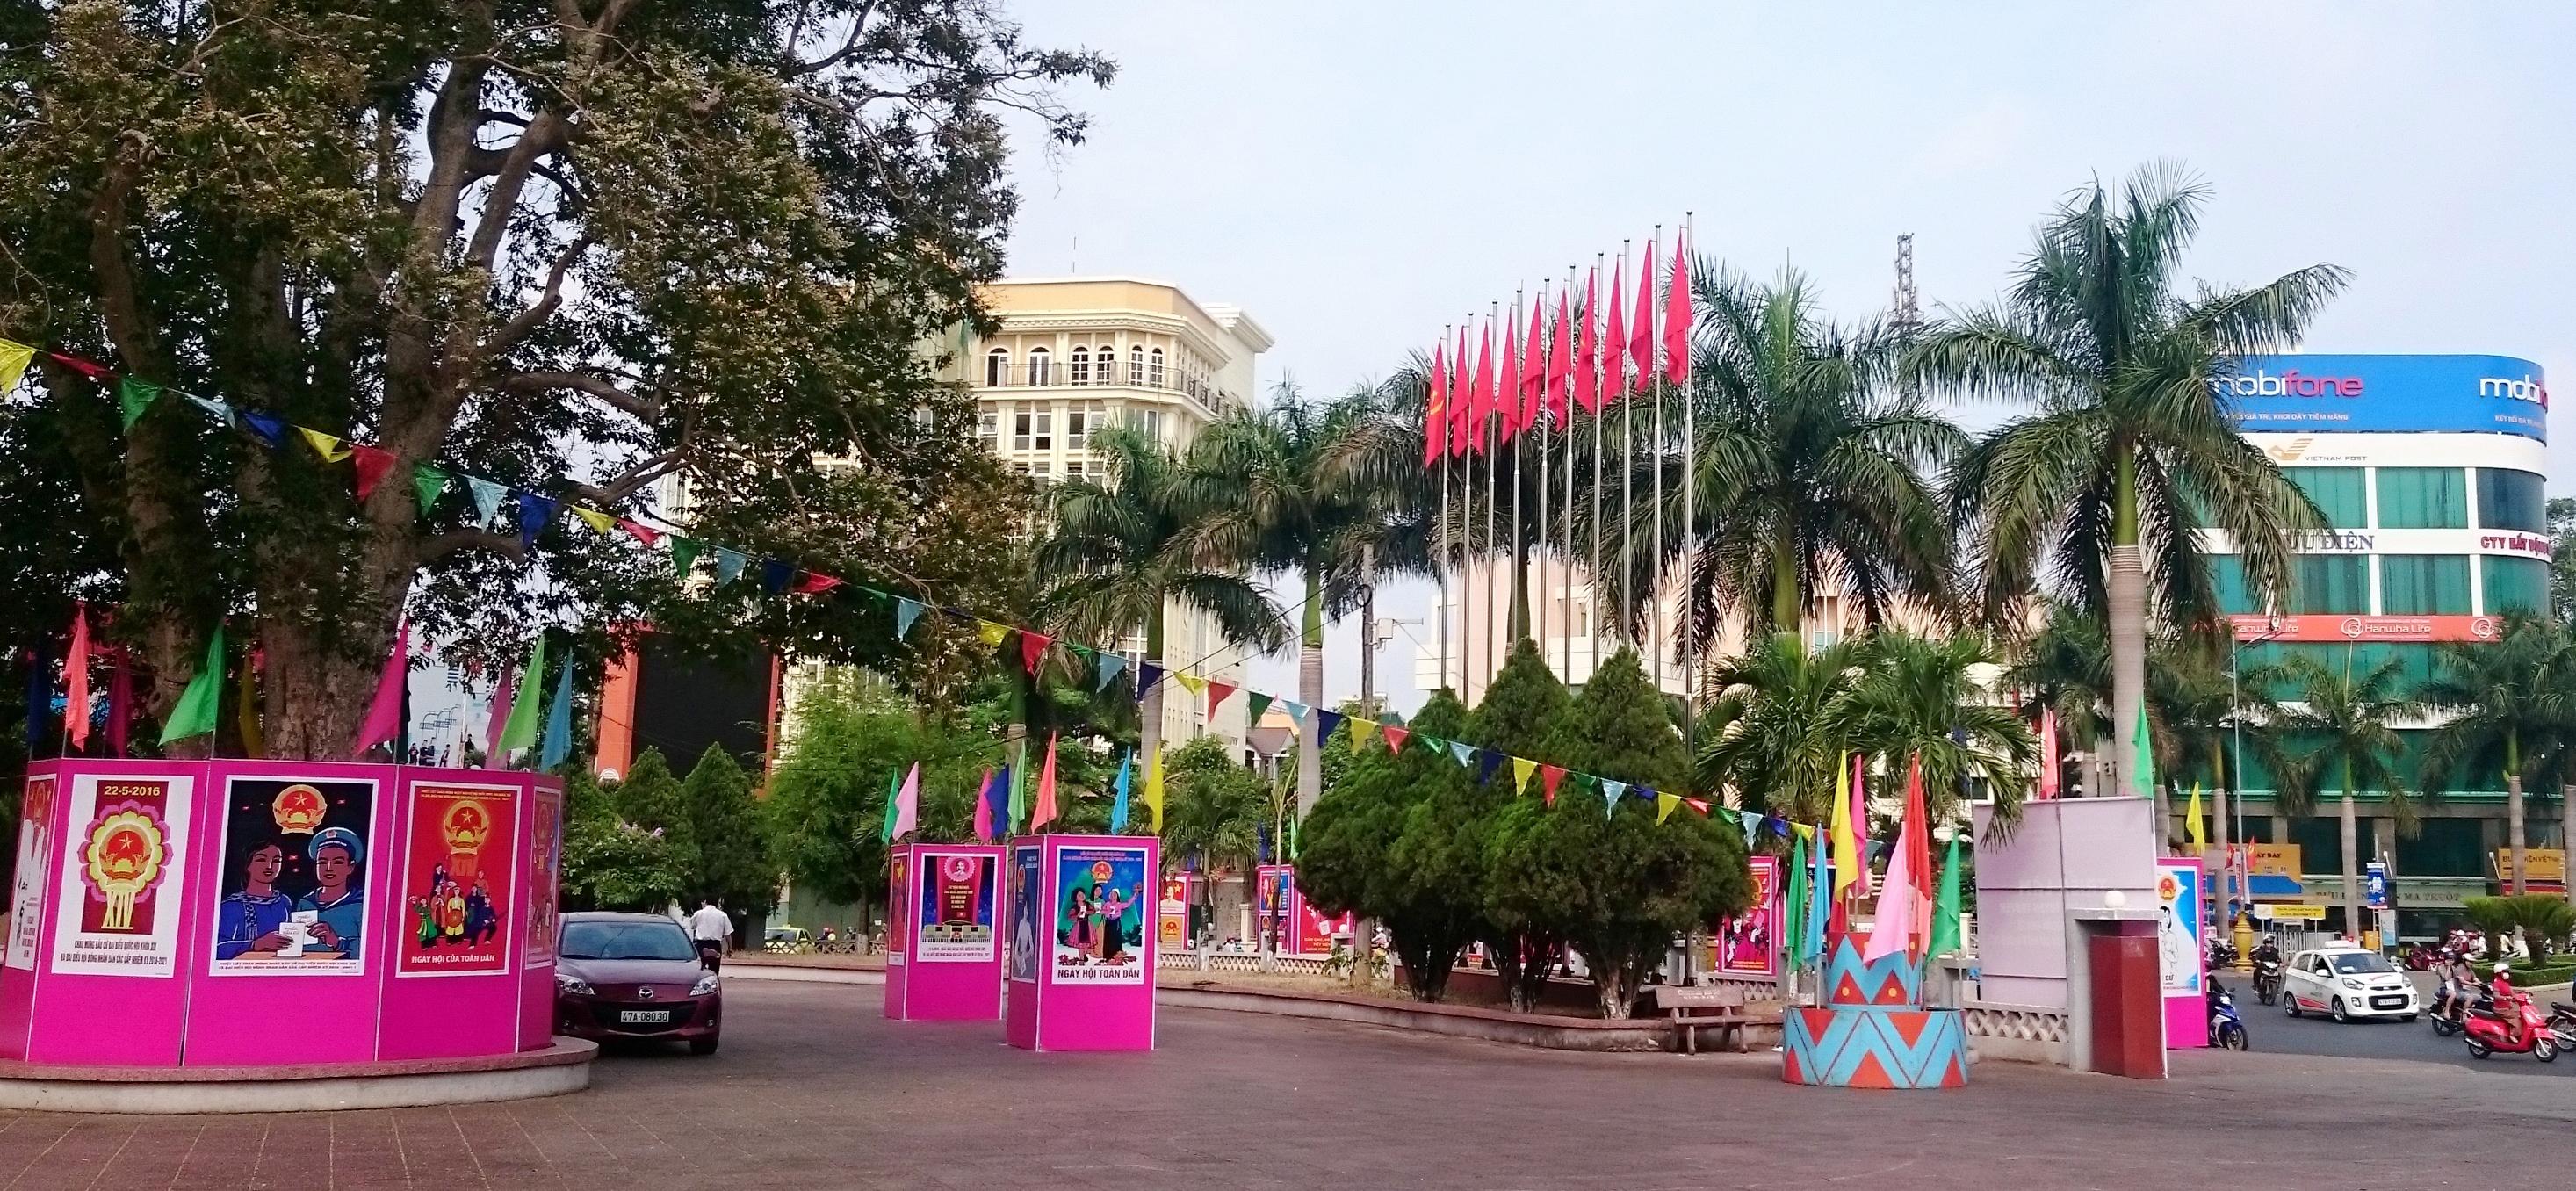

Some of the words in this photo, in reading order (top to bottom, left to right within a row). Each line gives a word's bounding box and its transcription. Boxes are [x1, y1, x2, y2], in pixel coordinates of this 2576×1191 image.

[2480, 536, 2506, 550] CTY
[2365, 624, 2409, 633] Hanwha
[2411, 624, 2431, 633] Life
[104, 785, 161, 797] 22-5-2016
[1082, 967, 1096, 980] HỘI
